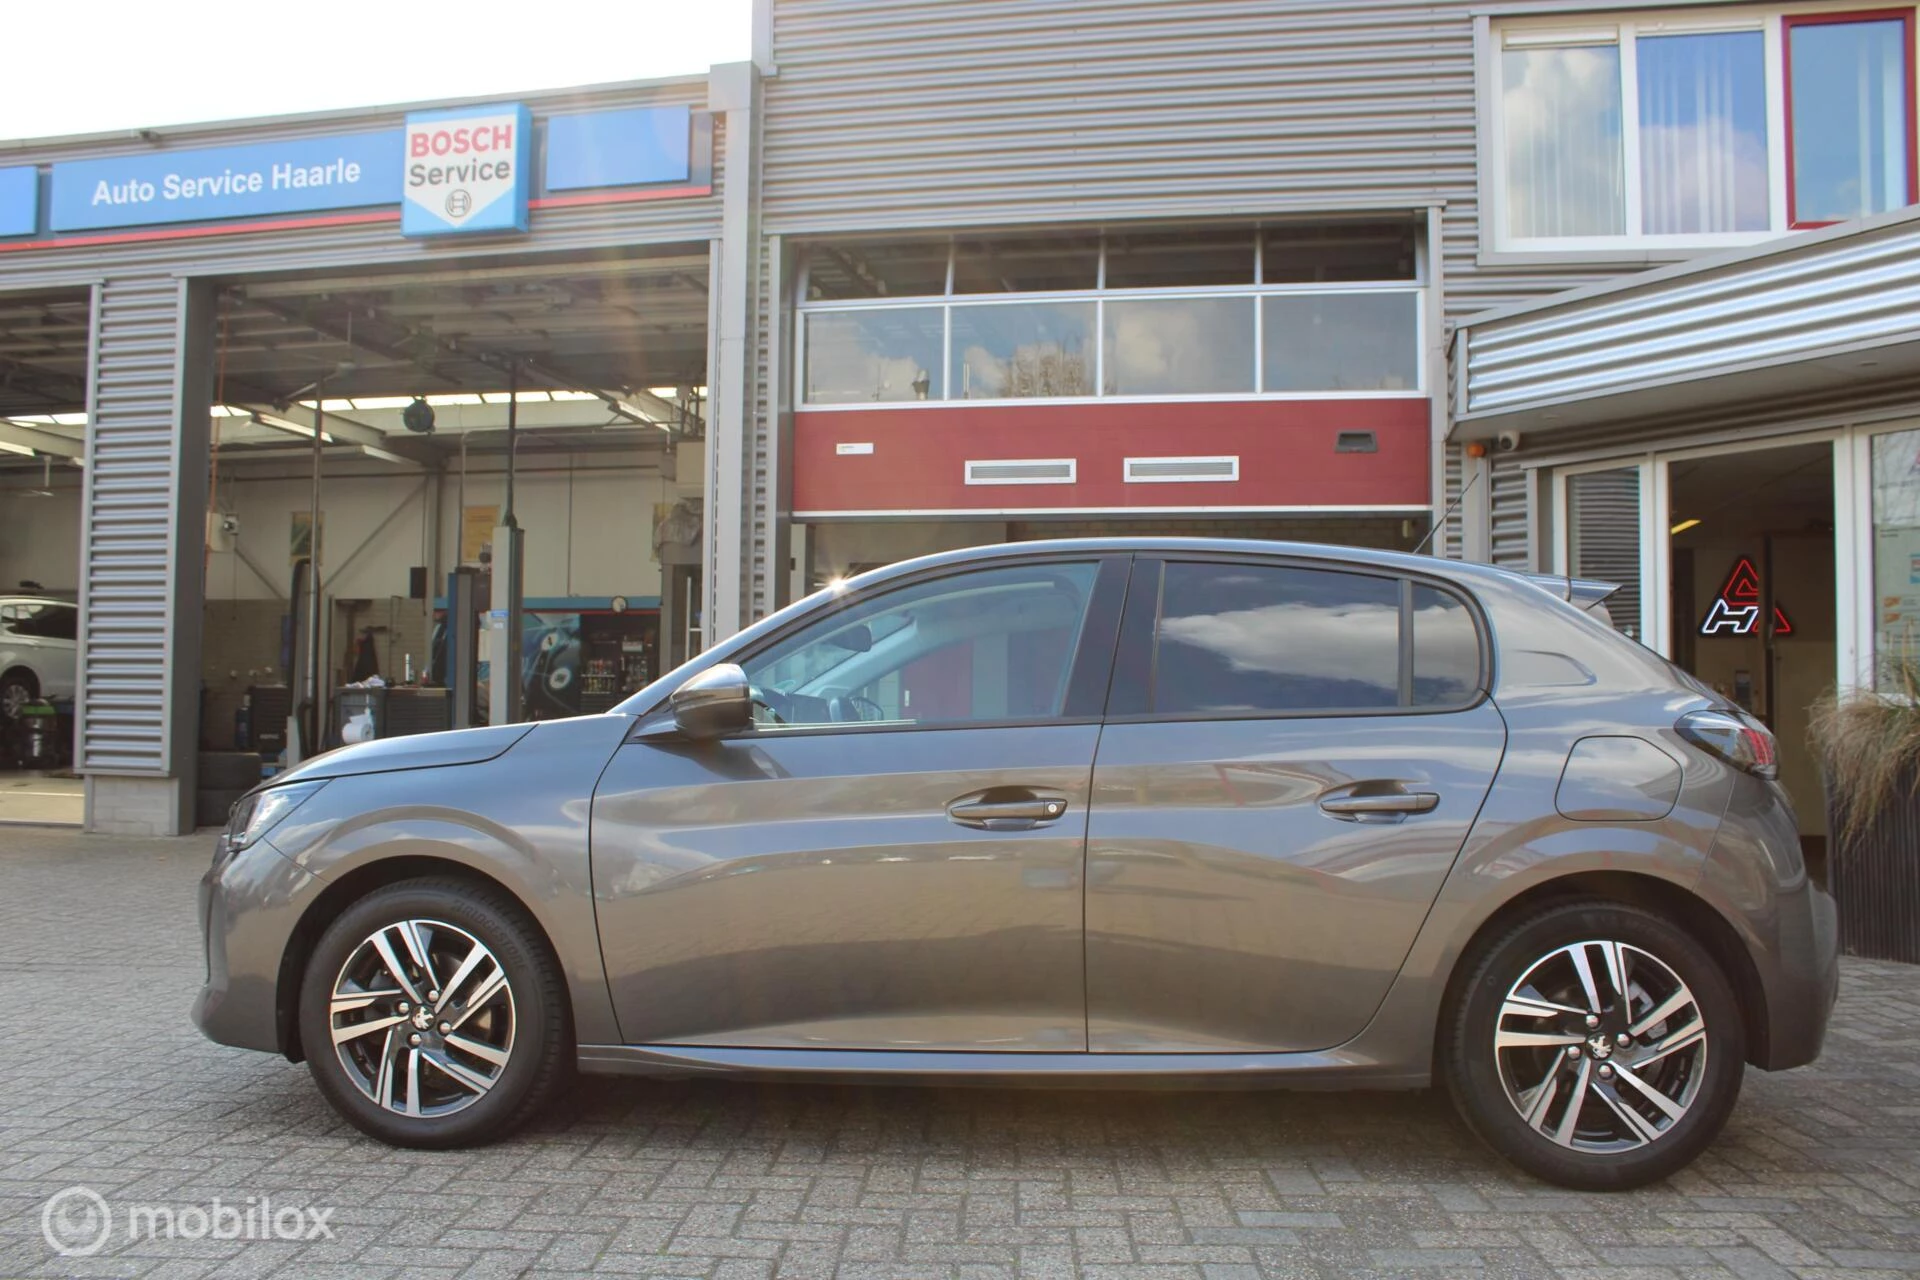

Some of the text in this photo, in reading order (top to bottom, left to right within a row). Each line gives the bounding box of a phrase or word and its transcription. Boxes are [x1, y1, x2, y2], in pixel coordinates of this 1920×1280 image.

[410, 124, 512, 158] BOSCH
[92, 157, 361, 206] Auto Service Haarle
[409, 157, 511, 187] Service
